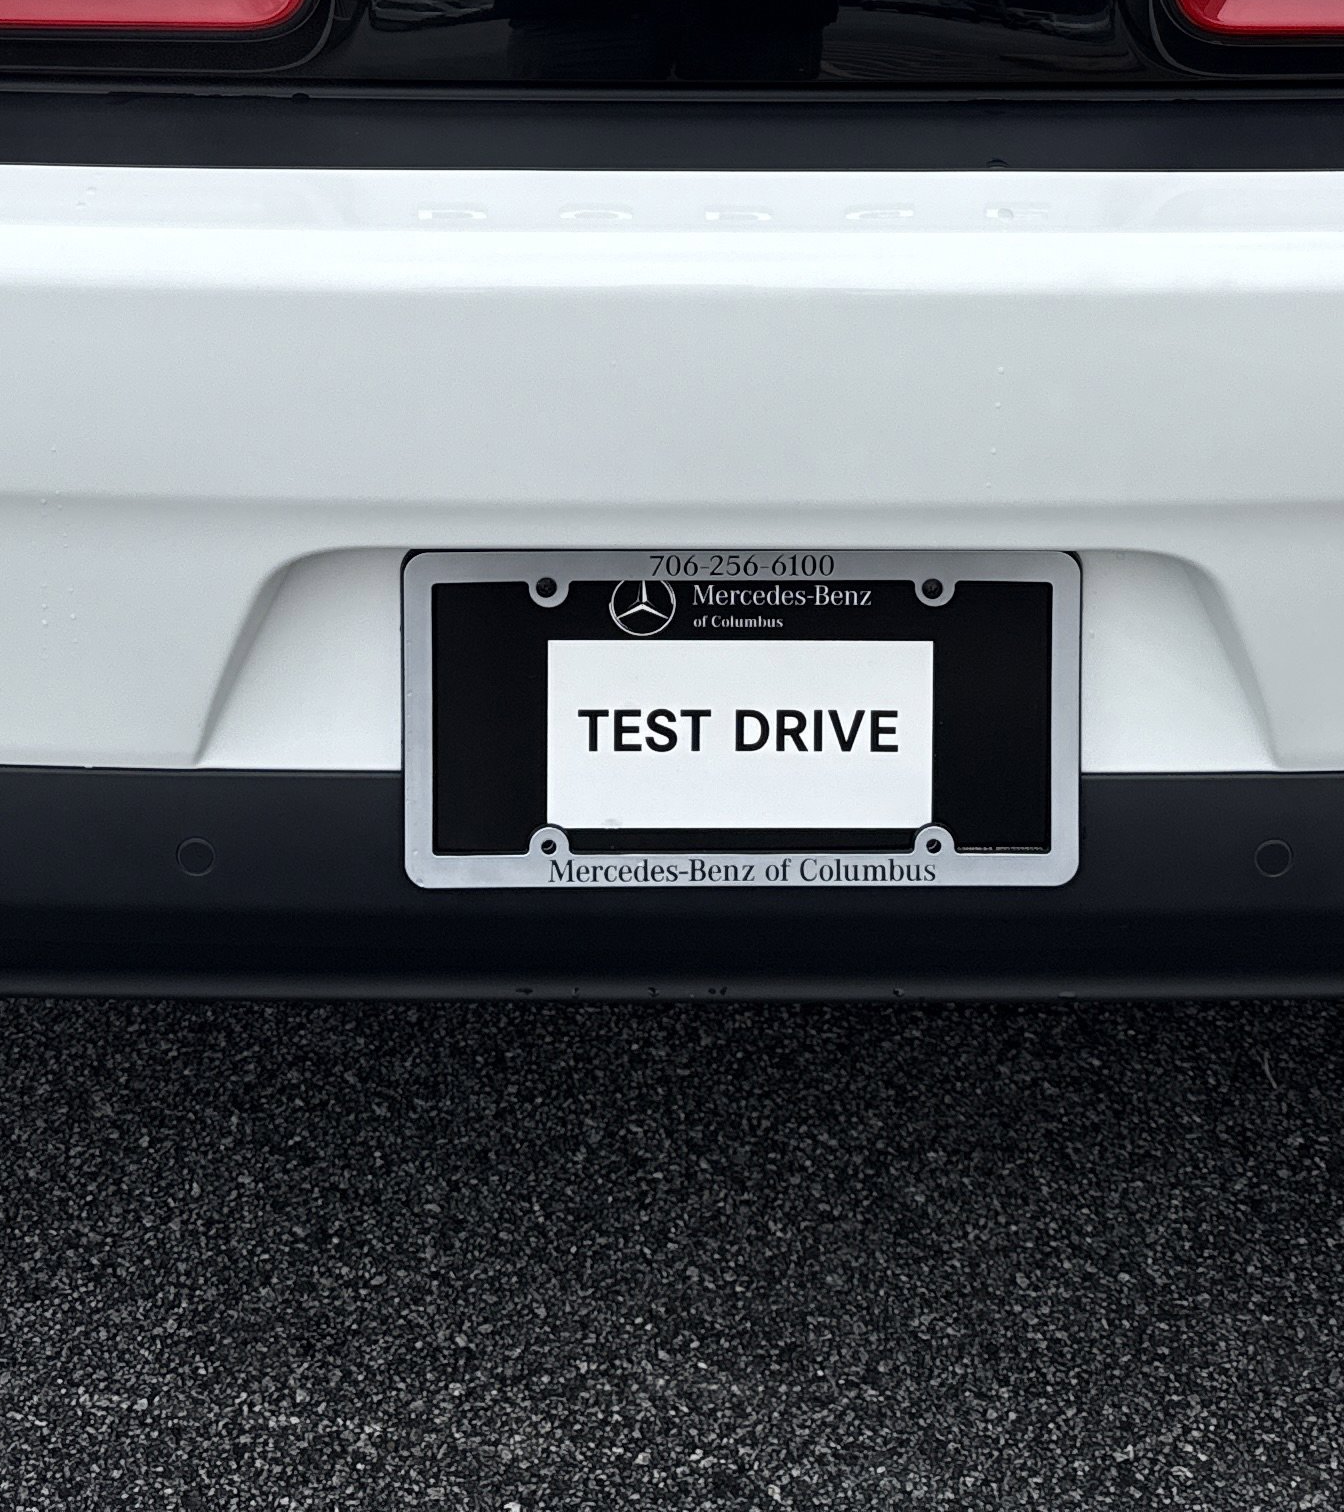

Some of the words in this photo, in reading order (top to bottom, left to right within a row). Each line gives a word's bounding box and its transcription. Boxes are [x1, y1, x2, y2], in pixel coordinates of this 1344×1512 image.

[648, 553, 836, 577] 706-256-6100
[692, 584, 873, 607] Mercedes-Benz
[693, 615, 709, 629] of
[711, 615, 784, 629] Columbus
[577, 708, 712, 753] TEST
[734, 708, 899, 753] DRIVE
[547, 858, 756, 883] Mercedes-Benz
[765, 857, 792, 883] of
[799, 857, 937, 883] Columbus
